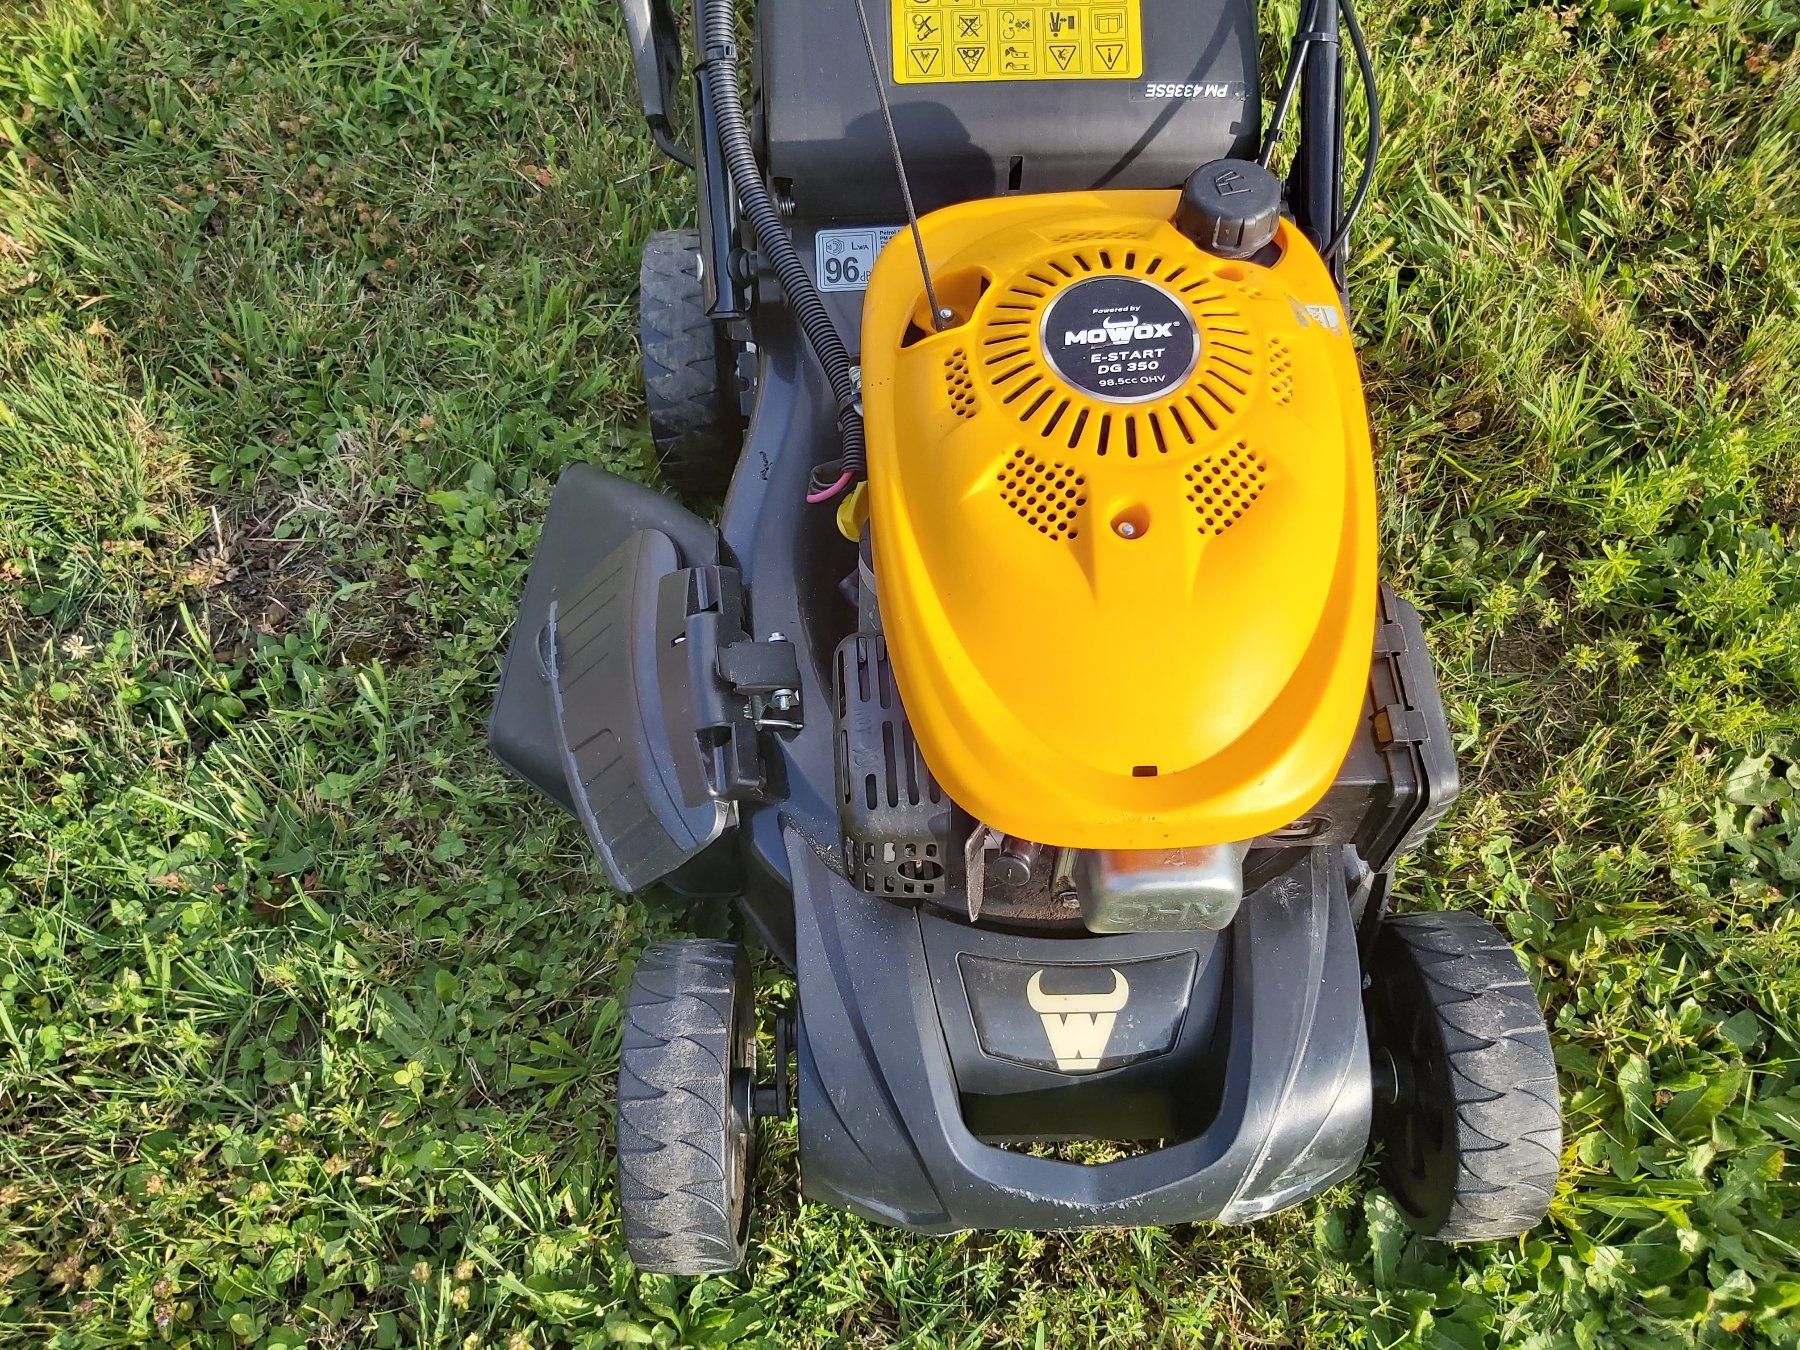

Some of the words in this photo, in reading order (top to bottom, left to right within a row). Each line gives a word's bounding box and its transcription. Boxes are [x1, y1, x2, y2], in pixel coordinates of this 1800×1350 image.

[1145, 84, 1204, 98] 4335SE
[1204, 84, 1228, 98] PM
[825, 256, 860, 283] 96
[1092, 306, 1128, 314] Powered
[1129, 305, 1141, 313] by
[1090, 348, 1166, 363] E-START
[1097, 363, 1122, 375] DG
[1127, 361, 1159, 372] 350
[1098, 377, 1138, 387] 98.5cc
[1140, 375, 1166, 384] OHV
